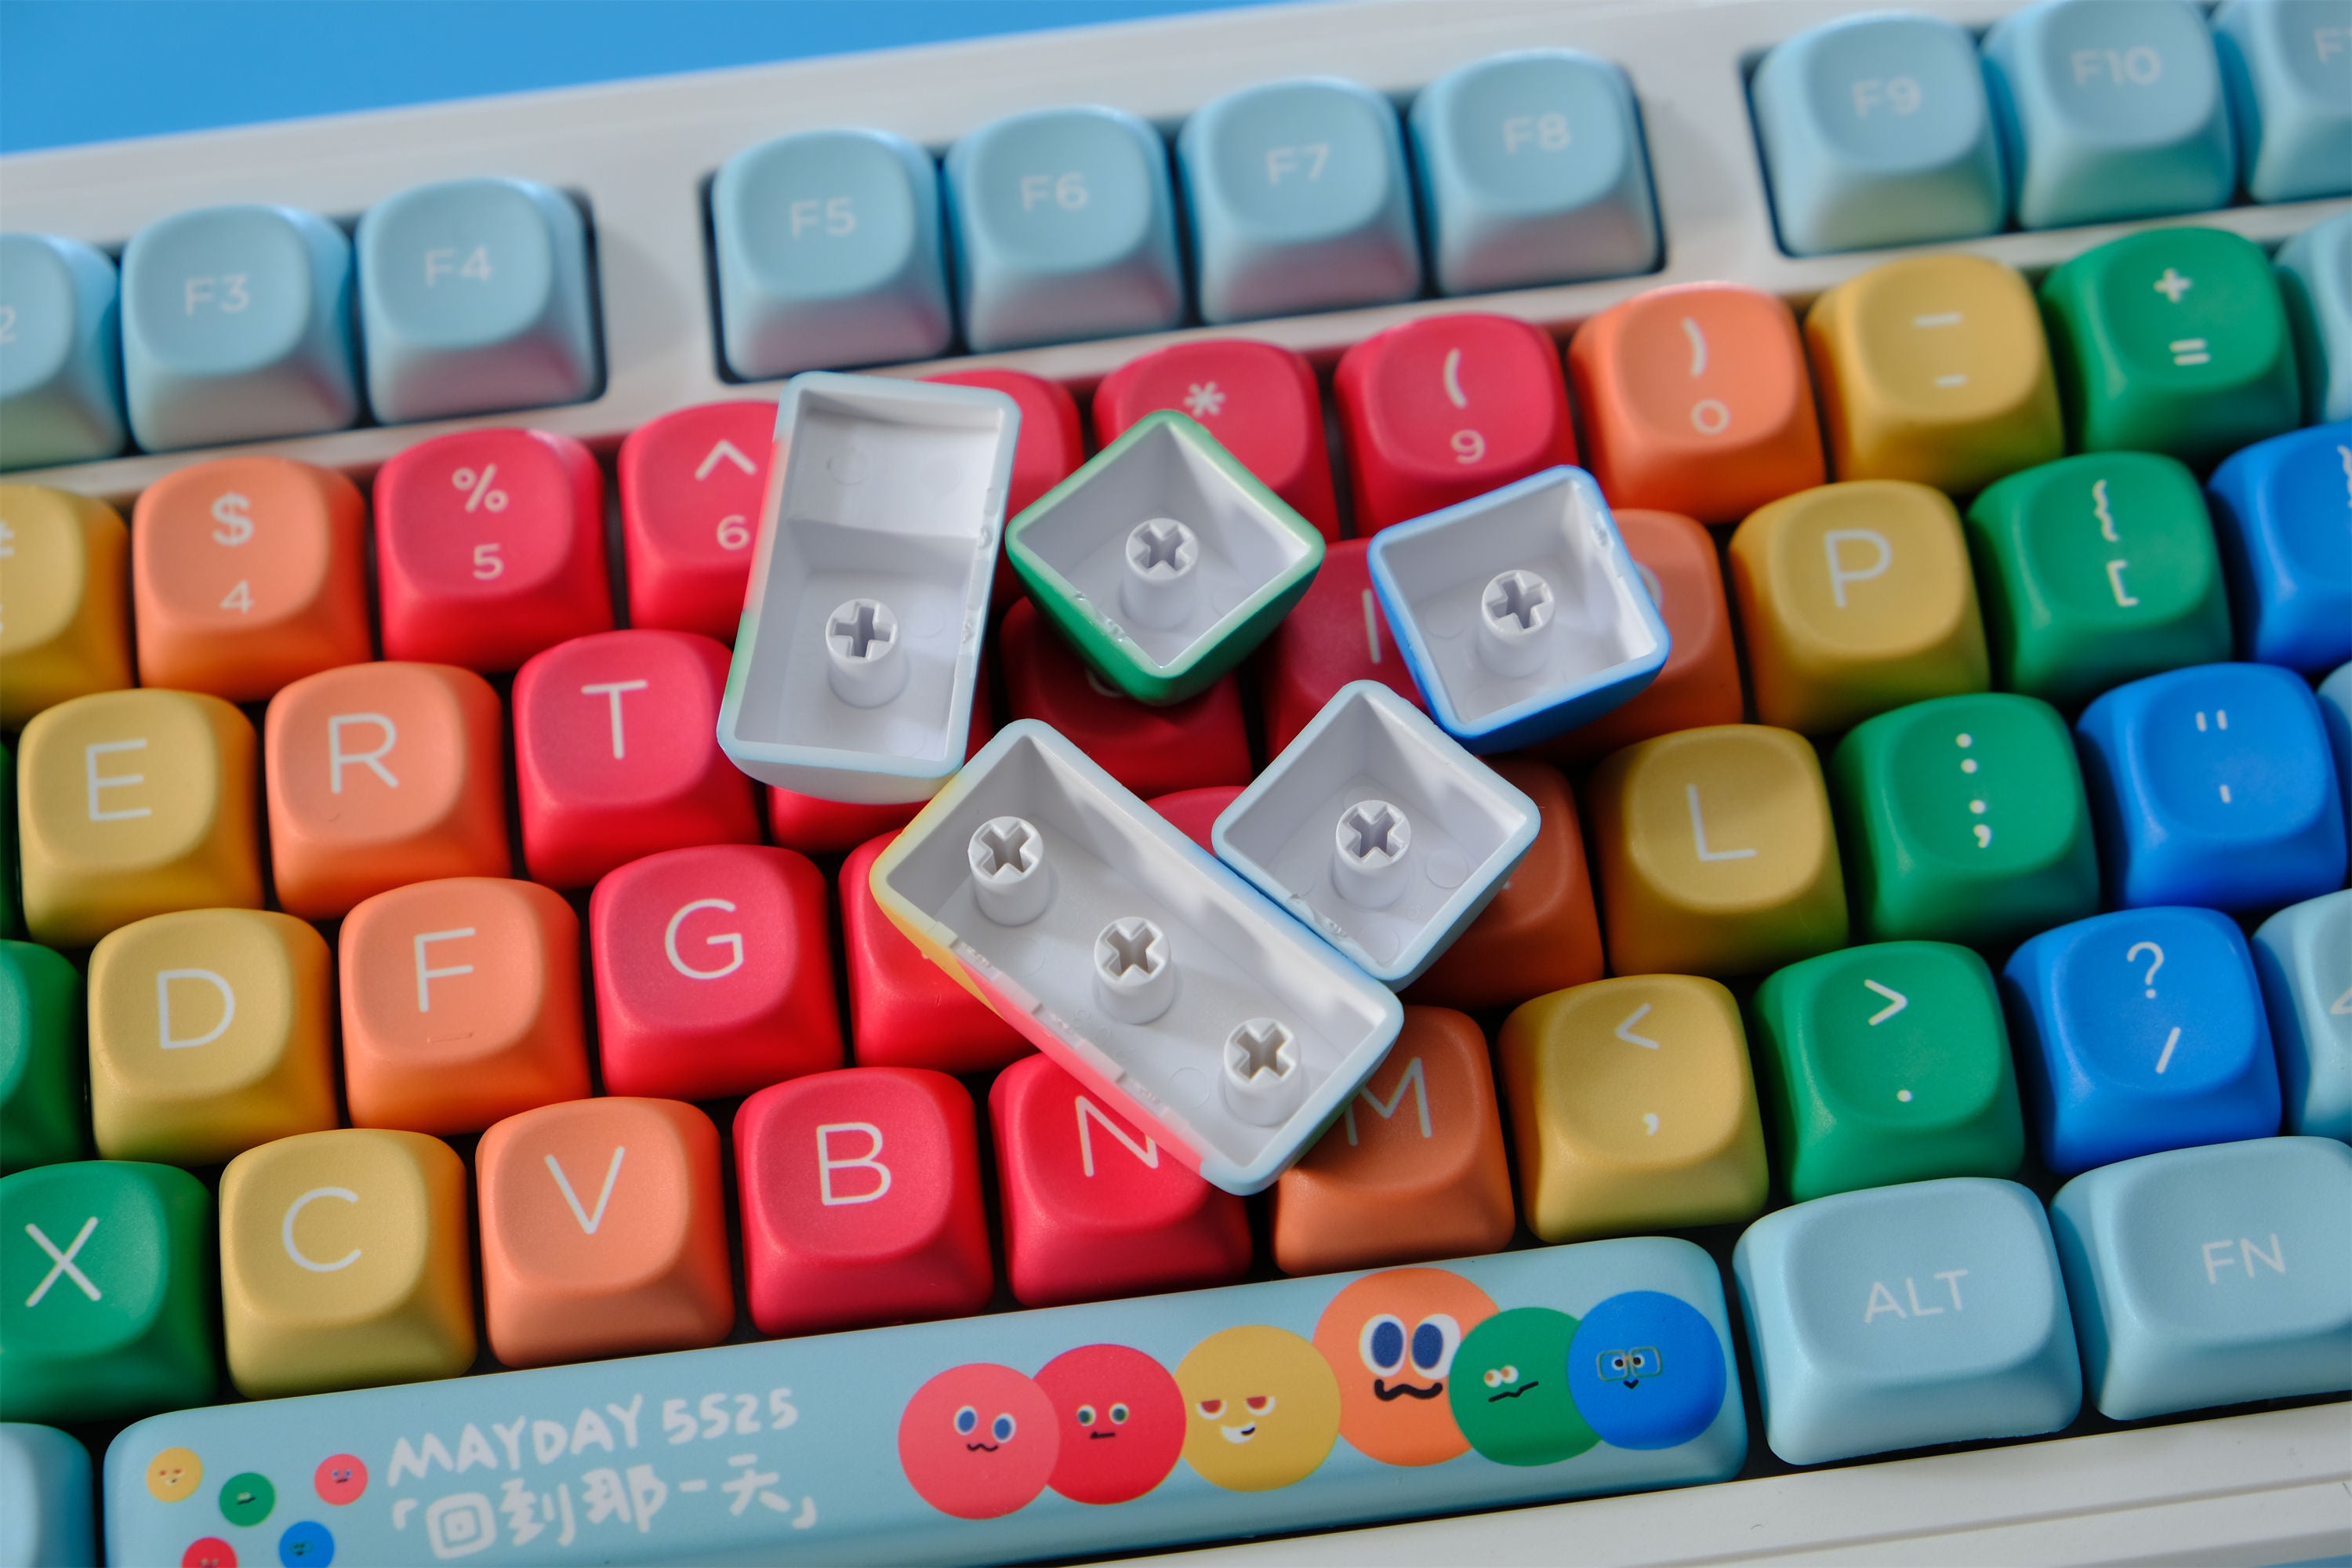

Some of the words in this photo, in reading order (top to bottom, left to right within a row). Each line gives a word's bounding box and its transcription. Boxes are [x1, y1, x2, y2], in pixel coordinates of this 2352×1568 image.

[2071, 46, 2160, 87] F10
[1852, 77, 1922, 118] F9
[1503, 114, 1570, 155] F8
[1020, 172, 1089, 212] F6
[1265, 143, 1330, 186] F7
[789, 196, 855, 241] F5
[423, 246, 492, 288] F4
[183, 274, 251, 318] F3
[1450, 430, 1485, 464] 9
[452, 463, 508, 513] %
[211, 492, 253, 546] $
[717, 514, 750, 550] 6
[473, 543, 503, 579] 5
[1824, 528, 1893, 608] P
[220, 580, 254, 614] 4
[581, 679, 648, 760] T
[85, 738, 152, 822] E
[328, 712, 398, 794] R
[1687, 784, 1757, 862] L
[664, 898, 744, 980] G
[414, 927, 475, 1012] F
[2126, 941, 2165, 1000] ?
[157, 968, 234, 1051] D
[1345, 1056, 1432, 1145] M
[816, 1122, 892, 1206] B
[1075, 1095, 1159, 1178] N
[545, 1145, 625, 1235] V
[281, 1186, 362, 1272] C
[25, 1216, 101, 1308] X
[2201, 1233, 2286, 1285] FN
[1864, 1269, 1969, 1324] ALT
[387, 1393, 644, 1487] MAYDAY
[662, 1388, 798, 1445] 5525
